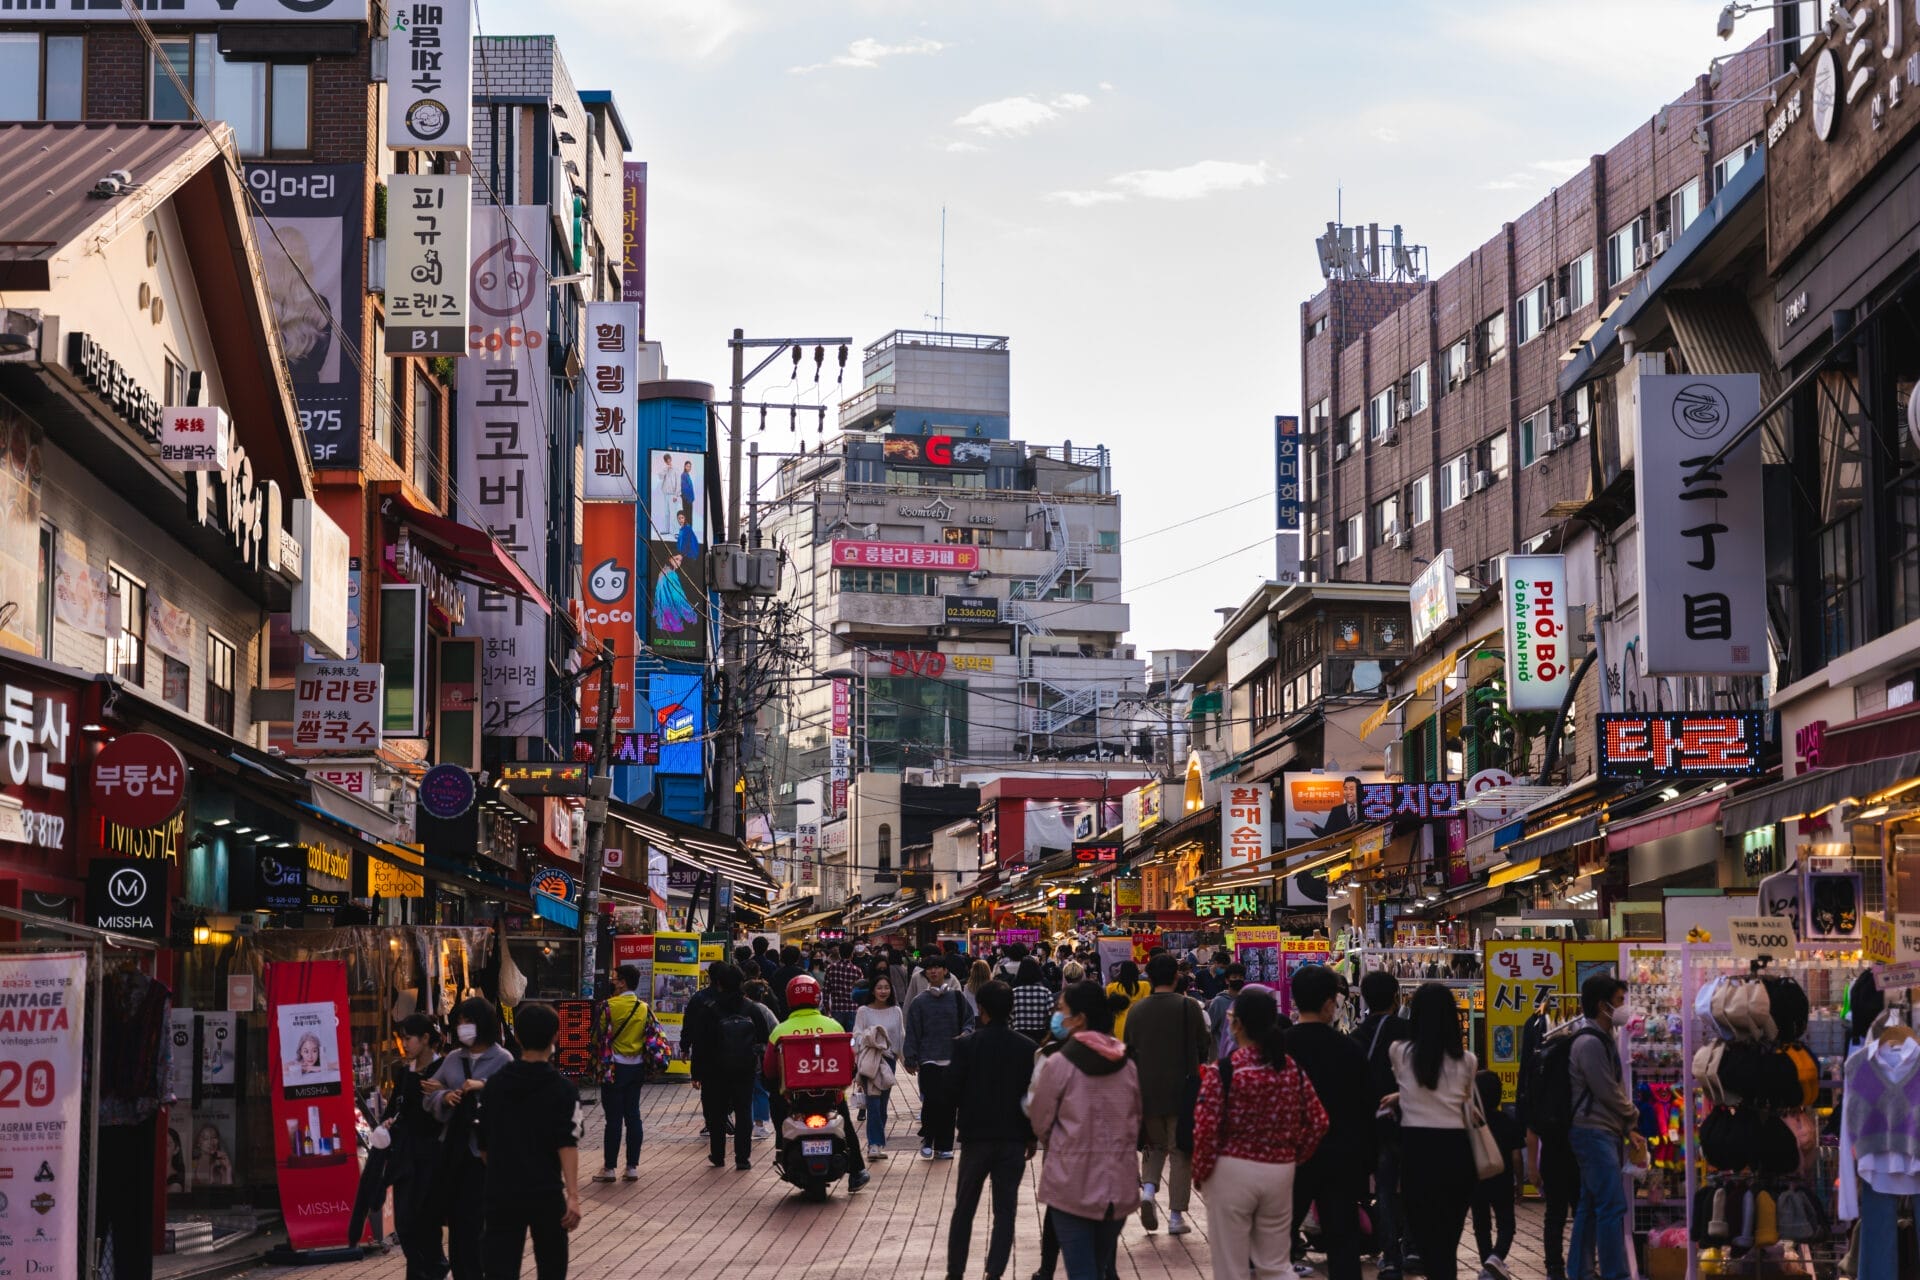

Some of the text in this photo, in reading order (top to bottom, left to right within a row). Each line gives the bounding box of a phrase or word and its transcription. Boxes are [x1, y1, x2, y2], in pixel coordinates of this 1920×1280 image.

[391, 293, 461, 317] 프렌즈
[411, 330, 439, 349] B1
[469, 324, 543, 352] CoCo
[313, 444, 338, 459] 3F
[1279, 439, 1297, 525] 호미화방
[958, 553, 971, 564] 8F
[1678, 455, 1732, 641] 三丁目
[413, 546, 466, 627] PHOTO FRIENDS
[1515, 579, 1530, 590] Ở
[585, 609, 632, 624] CoCo
[947, 608, 996, 618] 02.336.0502
[1516, 621, 1531, 650] BÁN
[1534, 581, 1565, 682] PHỞ BÒ
[486, 638, 516, 659] 홍대
[891, 650, 946, 678] DVD
[953, 656, 994, 671] 영화관
[1517, 653, 1533, 682] PHỞ
[299, 679, 378, 703] 마라탕
[484, 700, 521, 729] 2F
[296, 720, 376, 745] 쌀국수
[1607, 717, 1757, 771] 타로
[95, 765, 178, 797] 부동산
[318, 771, 363, 793] 문점
[1229, 787, 1262, 877] 할매순대
[374, 881, 417, 892] school
[375, 869, 391, 882] for
[311, 894, 338, 905] BAG
[98, 916, 153, 929] MISSHA
[1498, 951, 1554, 977] 힐링
[797, 1058, 839, 1073] 요기요
[296, 1088, 329, 1096] MISSHA
[36, 1121, 67, 1131] EVENT
[298, 1200, 350, 1217] MISSHA
